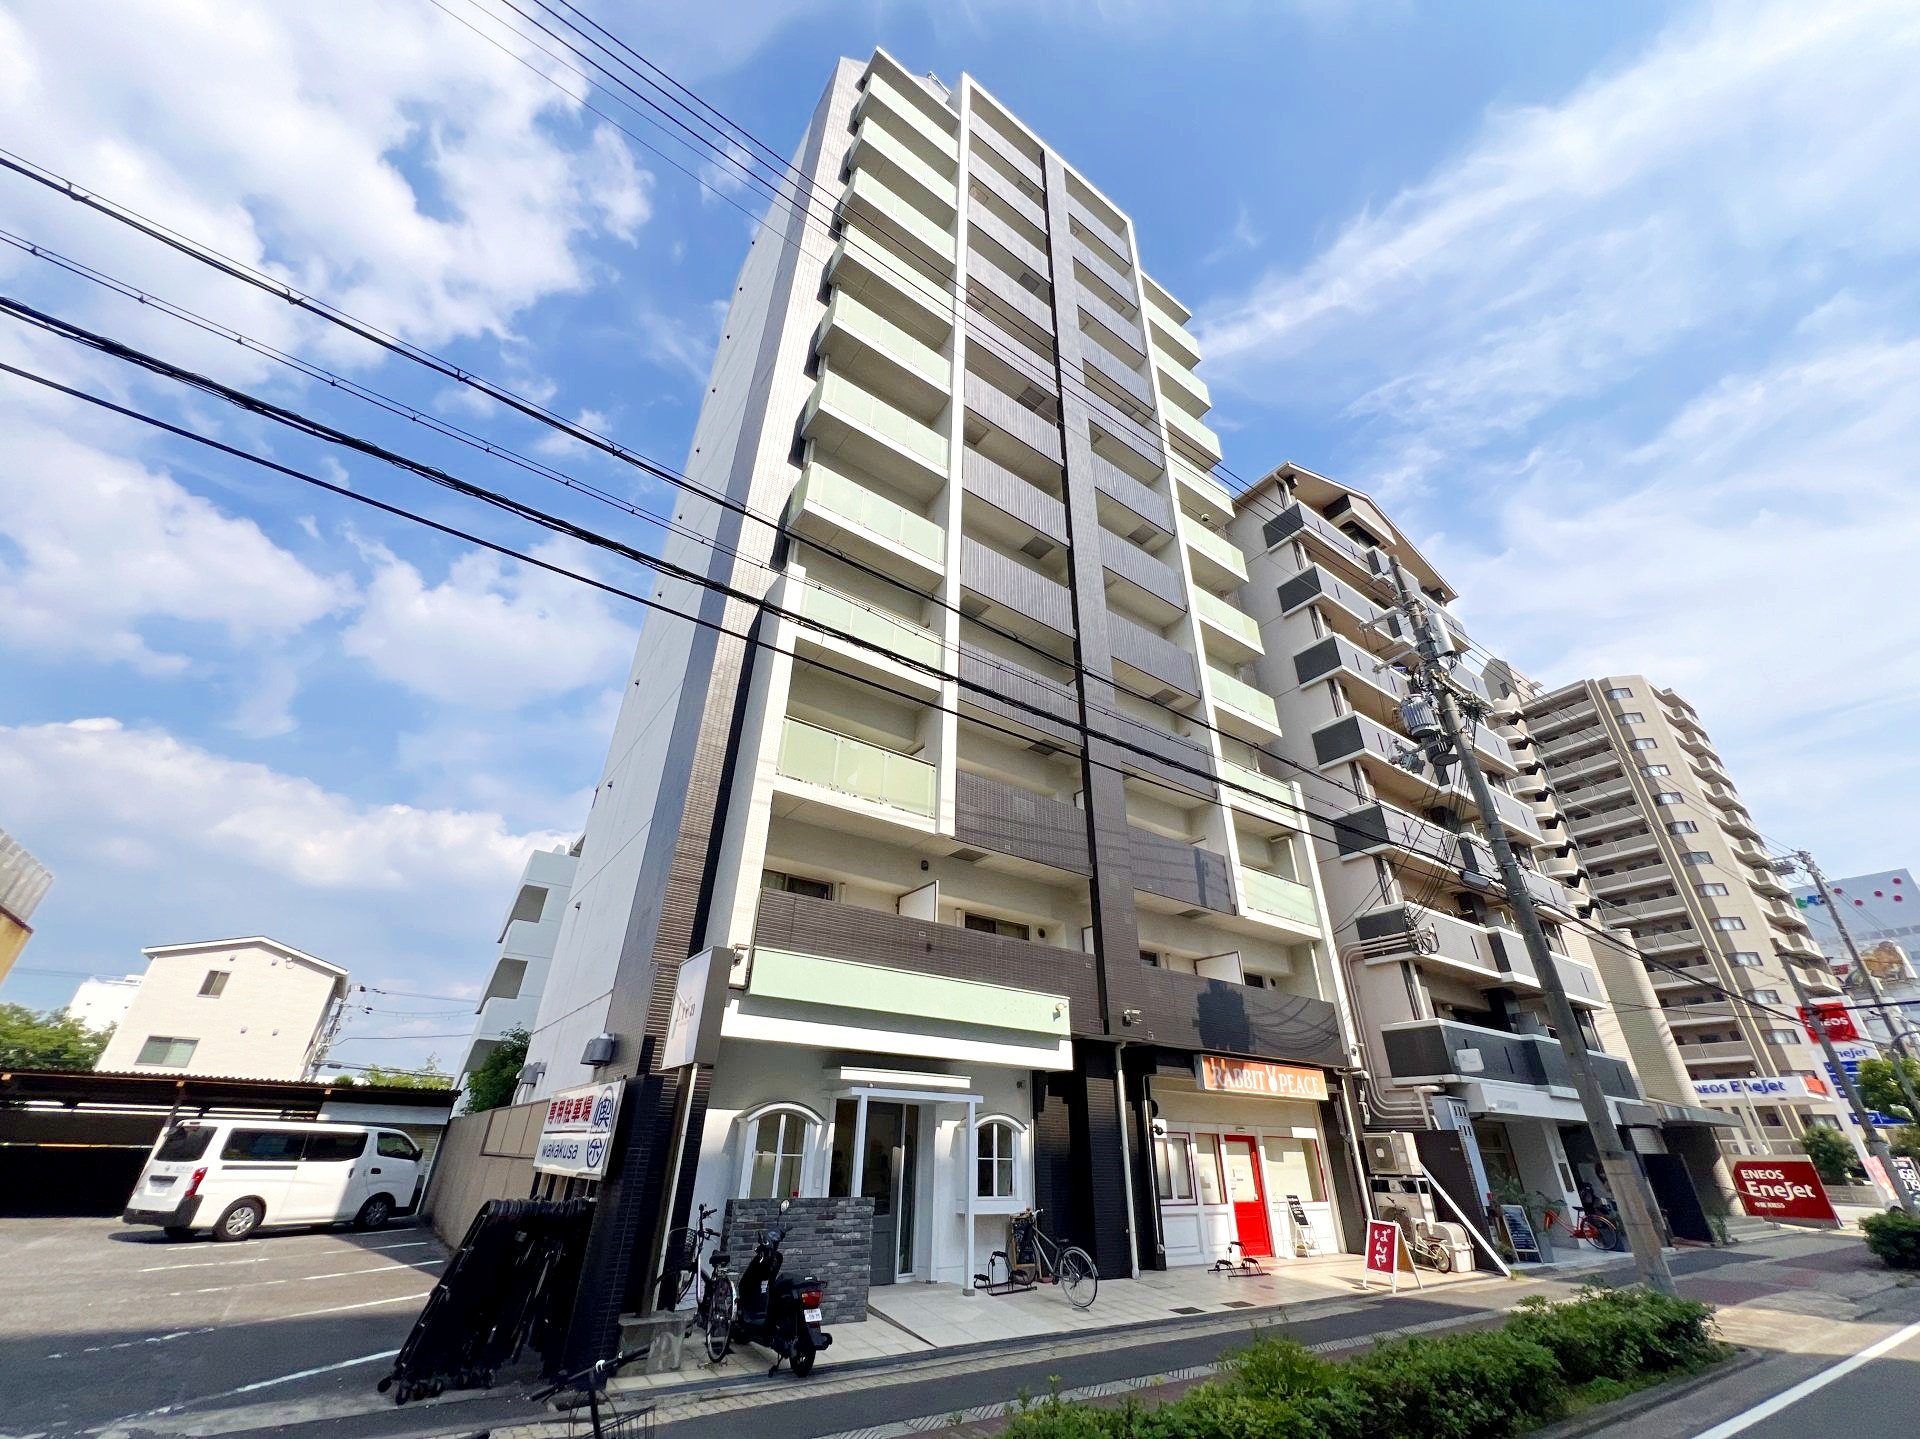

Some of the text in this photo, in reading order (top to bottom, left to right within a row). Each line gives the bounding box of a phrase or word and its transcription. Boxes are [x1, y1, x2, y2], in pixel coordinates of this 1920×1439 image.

[1212, 1065, 1319, 1096] RABBIT PEACE
[1694, 1083, 1728, 1094] NEOS
[548, 1096, 593, 1125] 専用駐車場
[541, 1140, 579, 1160] wakakusa
[1740, 1169, 1785, 1180] ENEOS
